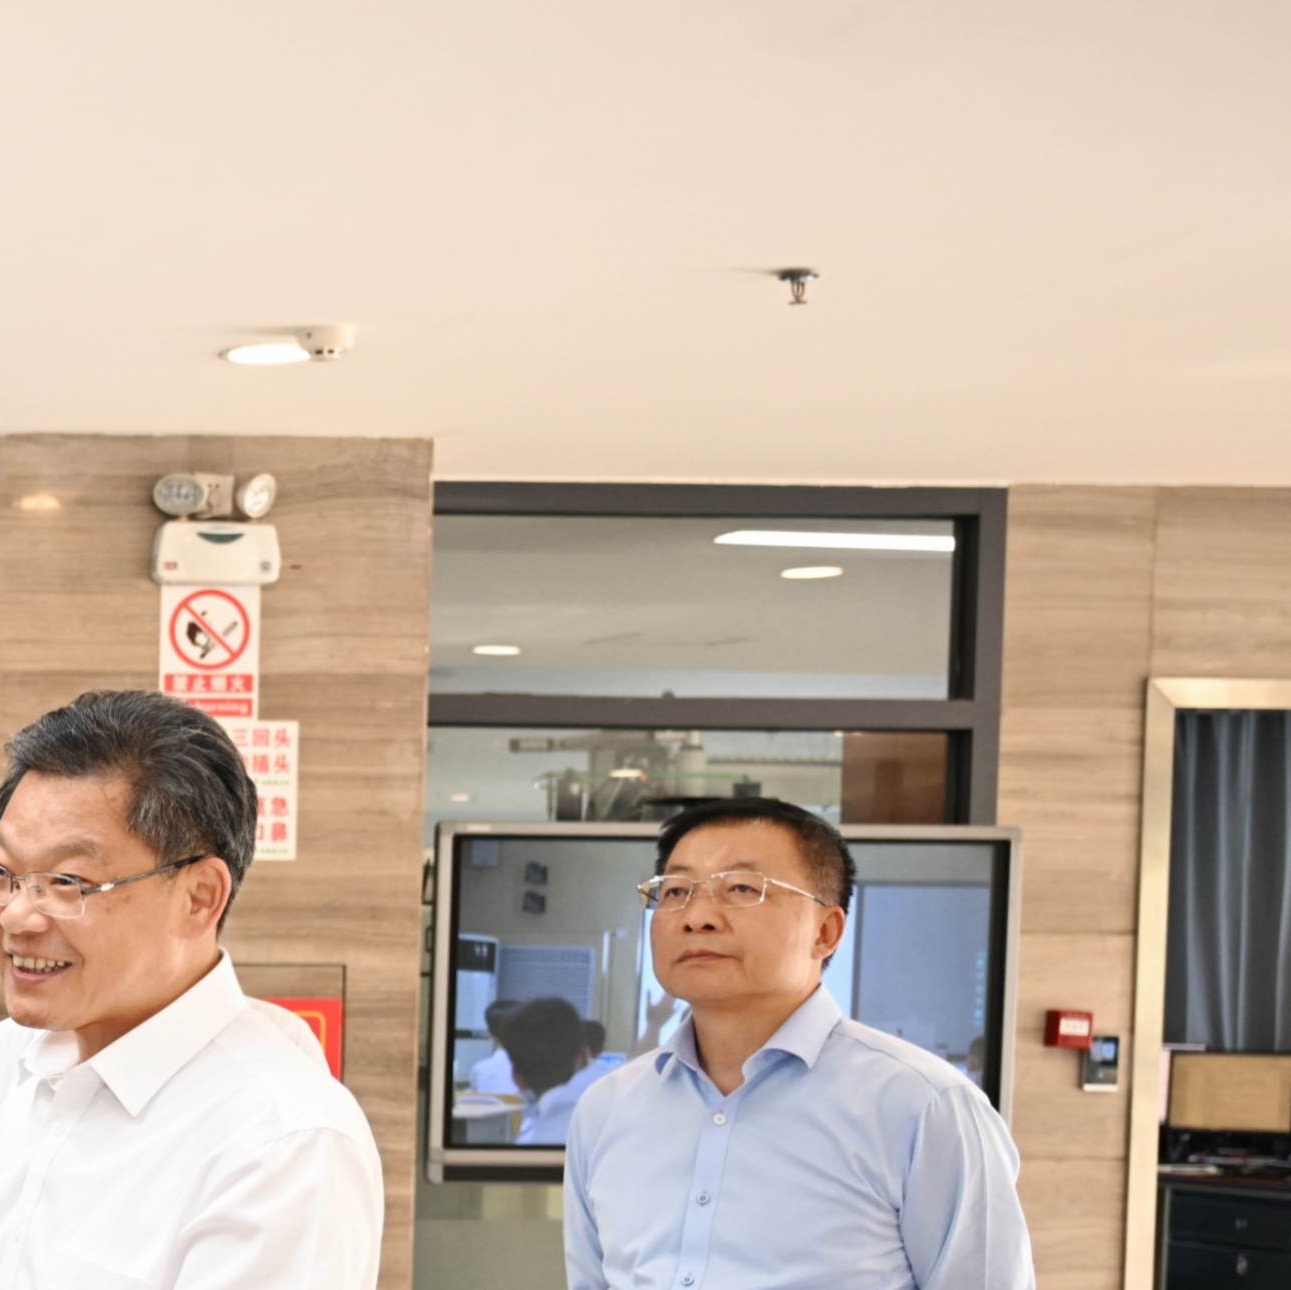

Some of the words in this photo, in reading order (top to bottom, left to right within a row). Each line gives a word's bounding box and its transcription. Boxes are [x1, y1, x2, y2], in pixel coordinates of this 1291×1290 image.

[171, 675, 246, 692] 禁止烟火
[244, 753, 291, 775] 插头
